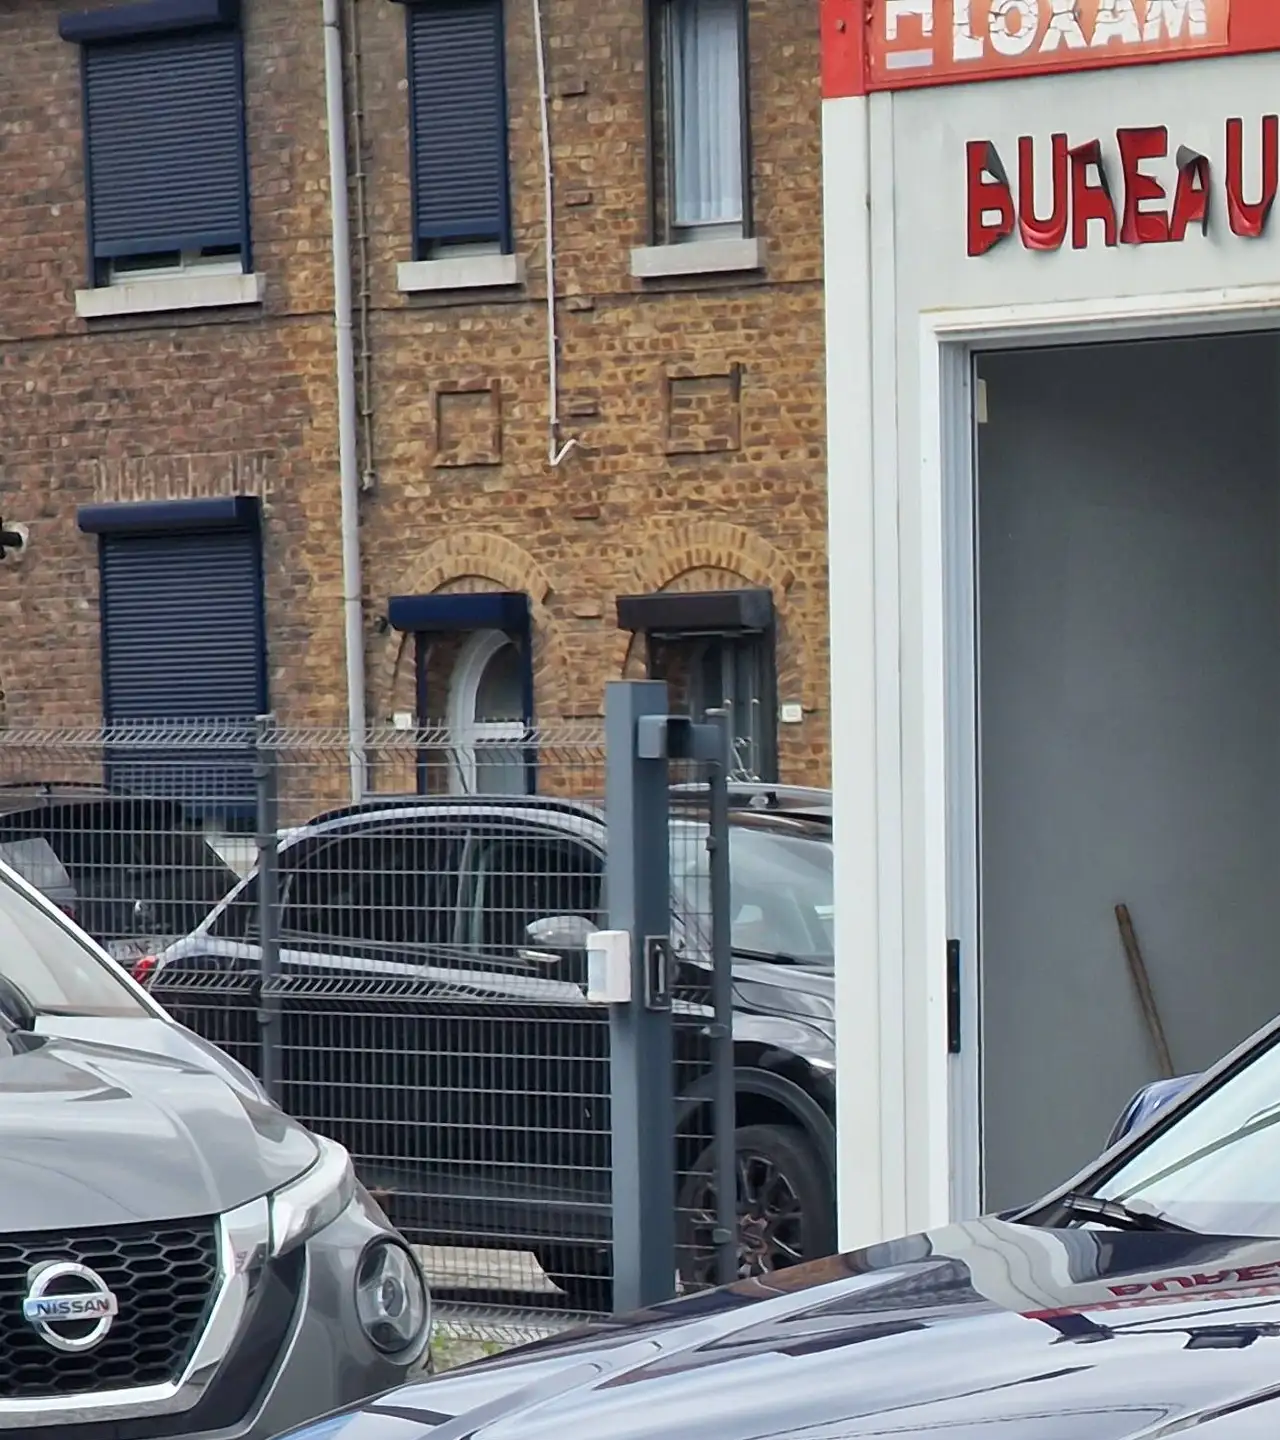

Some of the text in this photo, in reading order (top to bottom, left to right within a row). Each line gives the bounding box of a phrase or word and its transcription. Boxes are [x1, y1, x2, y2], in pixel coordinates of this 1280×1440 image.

[952, 0, 1208, 62] LOXAM
[965, 115, 1280, 258] BUREAU
[36, 1298, 110, 1315] NISSAN
